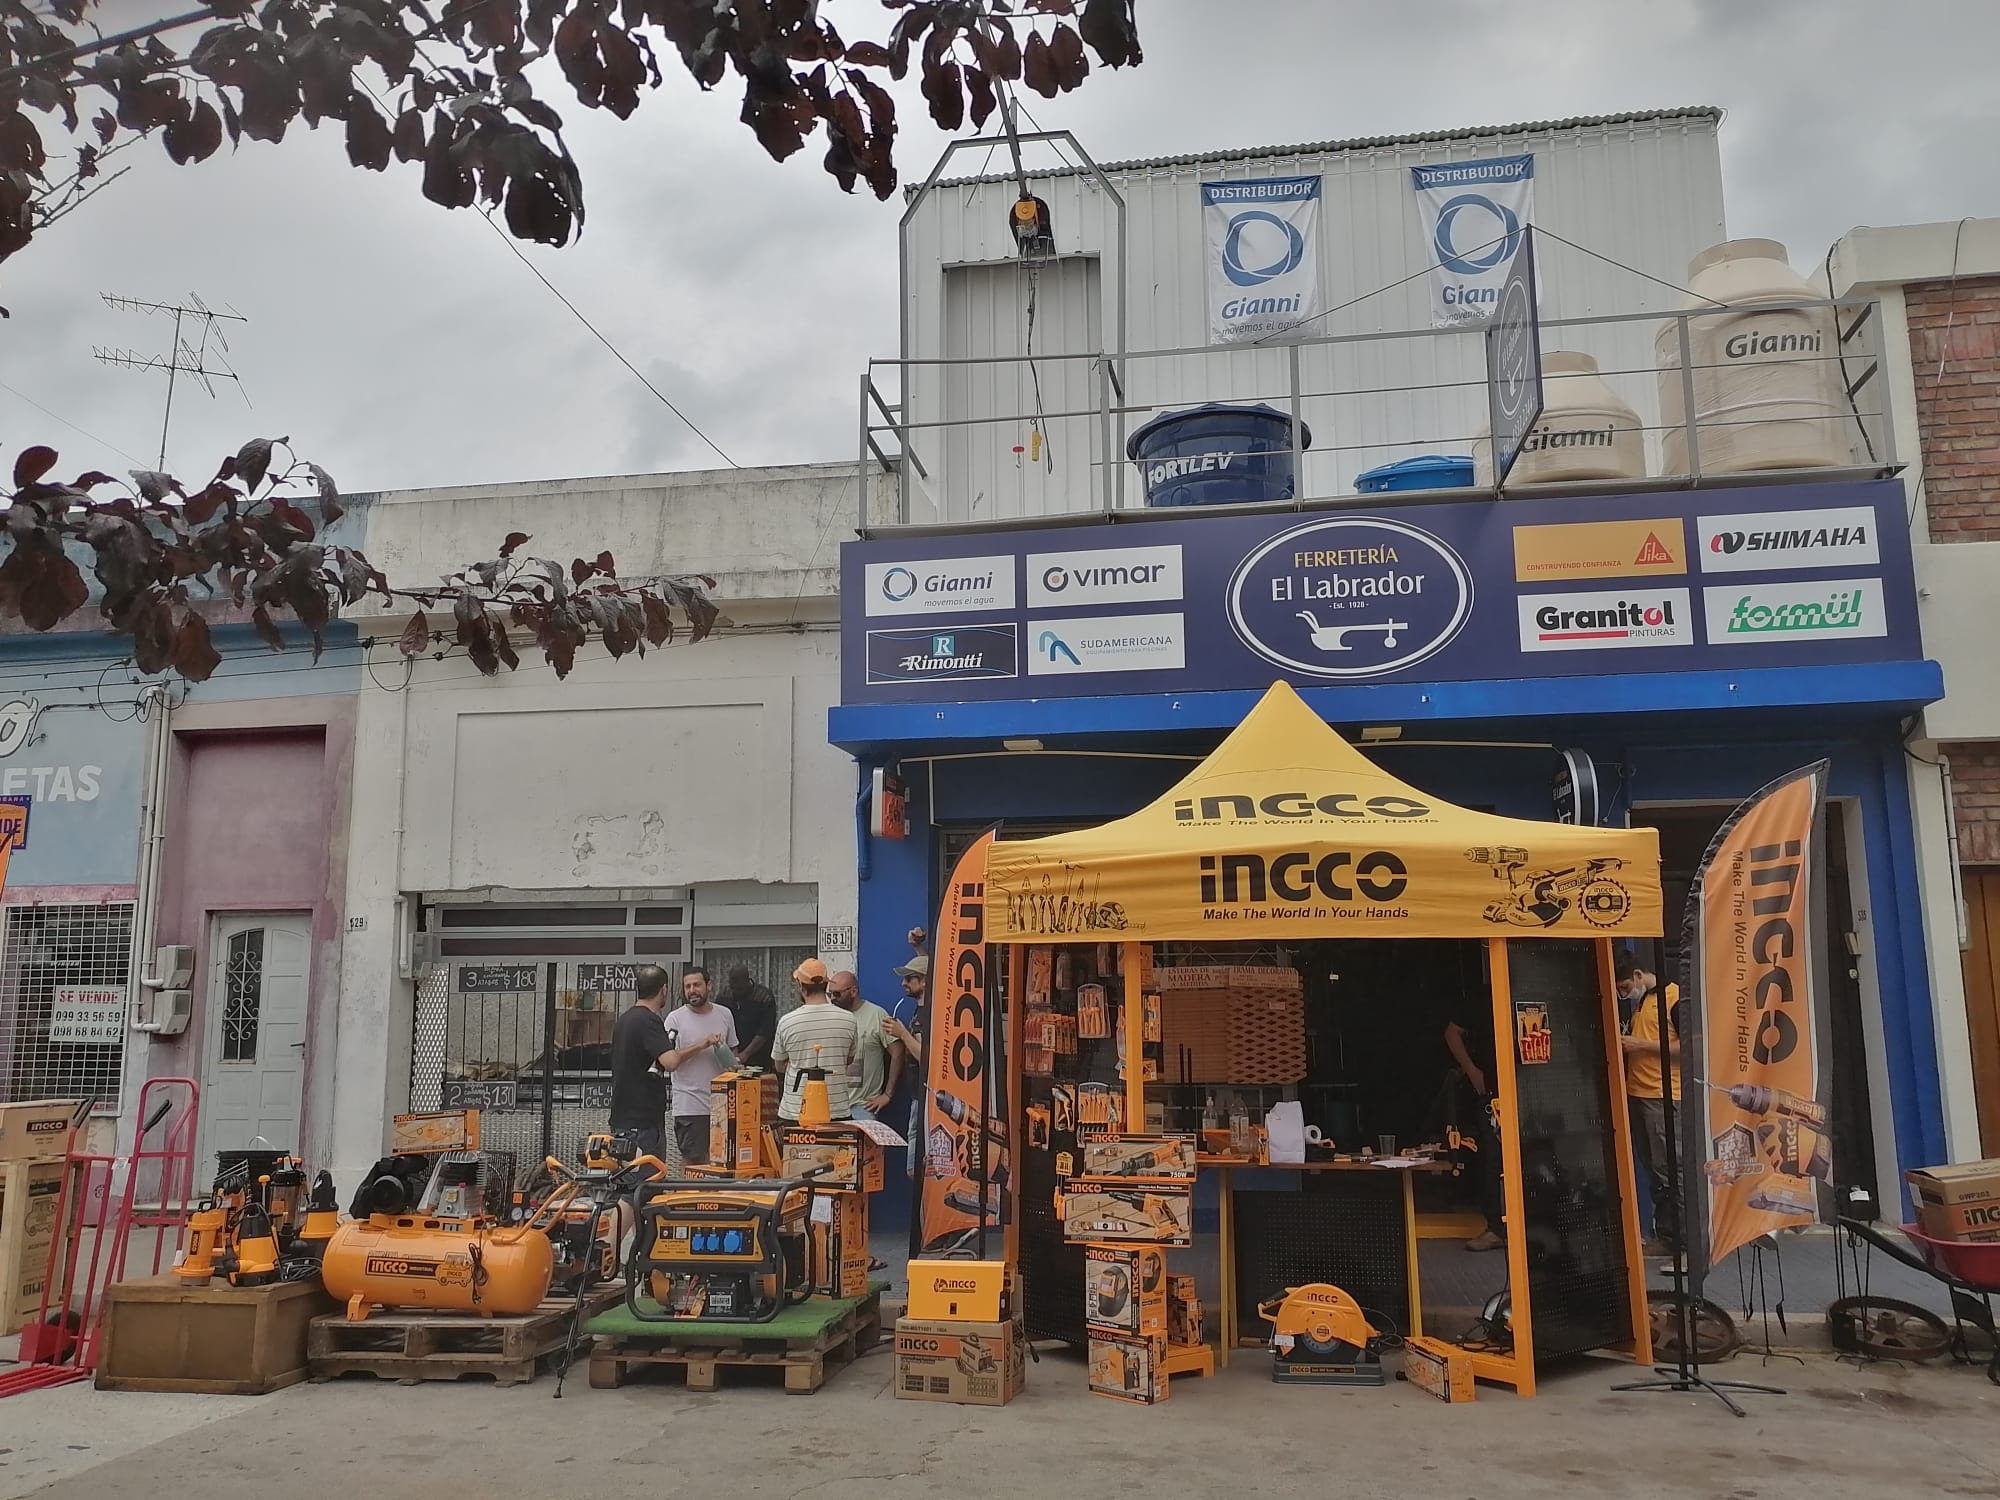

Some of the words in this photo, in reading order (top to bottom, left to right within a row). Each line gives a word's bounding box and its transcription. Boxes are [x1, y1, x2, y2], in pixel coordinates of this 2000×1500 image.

[1422, 163, 1524, 184] DISTRIBUIDOR
[1211, 183, 1312, 198] DISTRIBUIDOR
[1221, 293, 1301, 319] Gianni
[1222, 321, 1262, 335] movemos
[1725, 329, 1821, 359] Gianni
[1520, 424, 1614, 454] Gianni
[1148, 451, 1235, 488] FORTLEV
[1746, 527, 1867, 551] SHIMAHA
[1295, 544, 1399, 568] FERRETERÍA
[1639, 542, 1668, 564] Sika
[1527, 561, 1581, 571] CONSTRUYENDO
[1582, 560, 1622, 569] CONFIANZA
[924, 571, 993, 592] Gianni
[1271, 576, 1293, 601] El
[1303, 570, 1425, 600] Labrador
[924, 598, 963, 608] movemos
[965, 597, 972, 605] el
[973, 596, 994, 606] agua
[1728, 590, 1863, 633] formül
[1536, 600, 1674, 631] Granitol
[1080, 636, 1172, 649] SUDAMERICANA
[1629, 628, 1675, 638] PINTURAS
[1731, 851, 1745, 886] Make
[951, 883, 960, 916] Make
[1734, 891, 1745, 916] The
[1203, 908, 1238, 920] Make
[1242, 908, 1266, 919] The
[1271, 907, 1310, 919] World
[1315, 907, 1326, 918] In
[1331, 907, 1362, 919] Your
[1365, 907, 1409, 918] Hands
[827, 933, 846, 945] 531
[949, 920, 958, 944] The
[1734, 921, 1747, 963] World
[466, 971, 478, 988] 3
[513, 970, 537, 988] 180
[946, 948, 957, 988] World
[1168, 973, 1211, 982] MADERA
[1736, 968, 1746, 981] In
[583, 978, 598, 990] DE
[59, 990, 74, 1003] SE
[79, 991, 118, 1004] VENDE
[946, 992, 952, 1003] In
[1736, 987, 1749, 1021] Your
[56, 1010, 74, 1021] 099
[77, 1011, 89, 1021] 33
[943, 1007, 951, 1034] Your
[53, 1025, 72, 1037] 098
[941, 1037, 951, 1081] Hands
[1737, 1024, 1750, 1072] Hands
[449, 1085, 461, 1106] 2
[492, 1086, 514, 1106] 130
